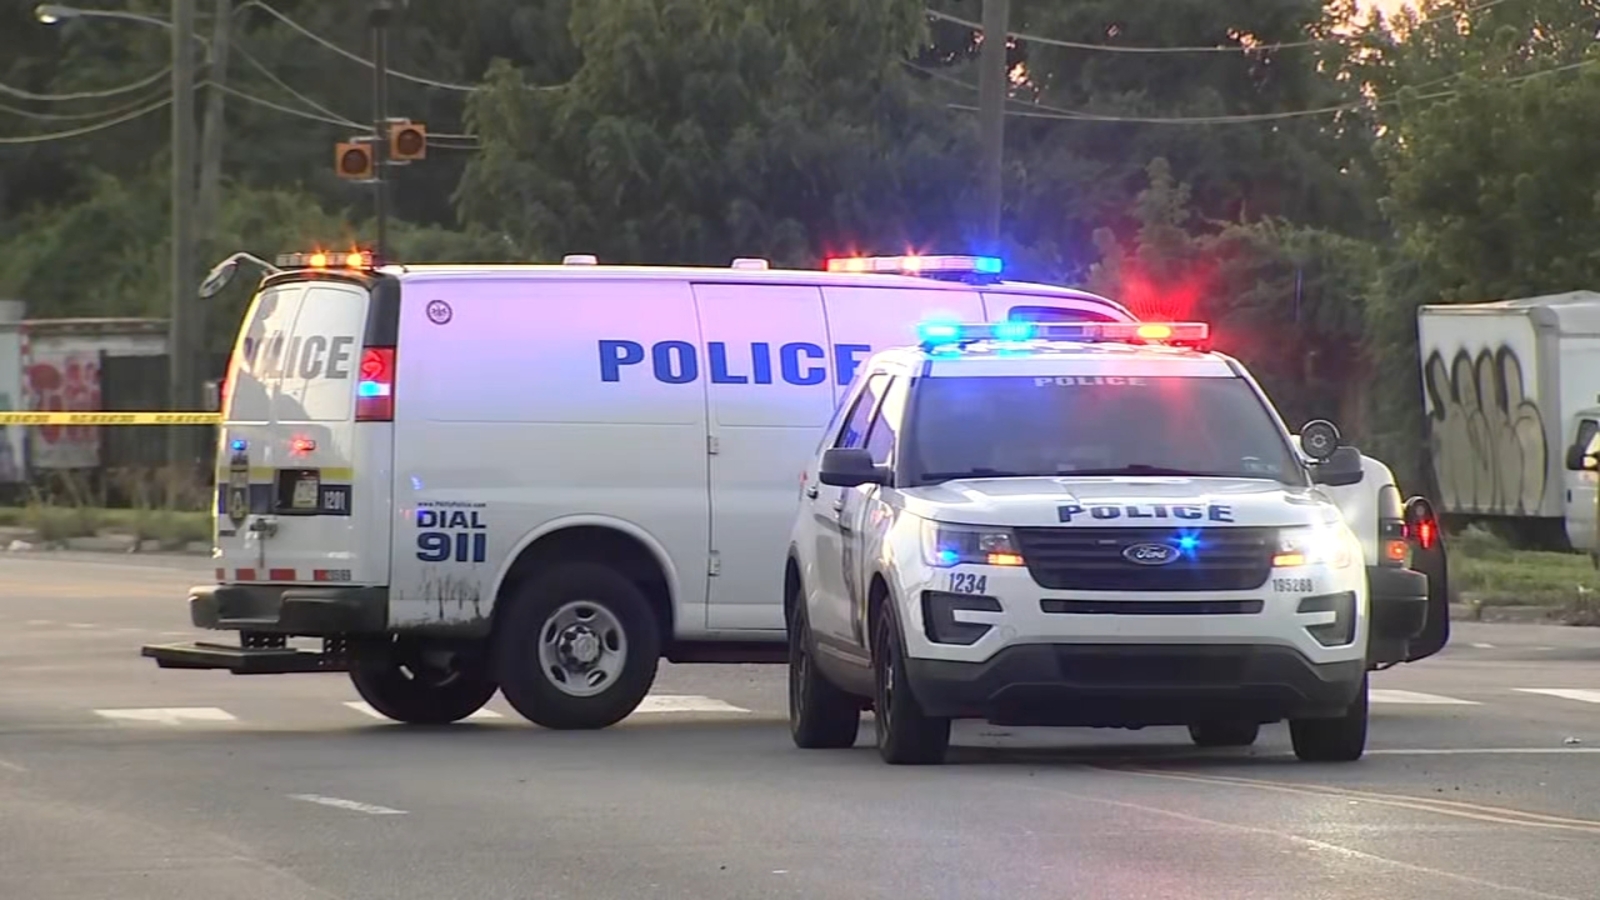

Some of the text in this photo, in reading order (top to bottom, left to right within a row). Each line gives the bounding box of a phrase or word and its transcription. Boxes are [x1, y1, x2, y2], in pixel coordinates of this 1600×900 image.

[243, 335, 354, 379] LICE
[598, 340, 871, 385] POLICE
[1034, 377, 1147, 387] POLICE
[416, 510, 487, 529] DIAL
[1057, 504, 1235, 523] POLICE
[416, 532, 487, 562] 911
[1135, 546, 1167, 559] Ford
[949, 572, 987, 594] 1234
